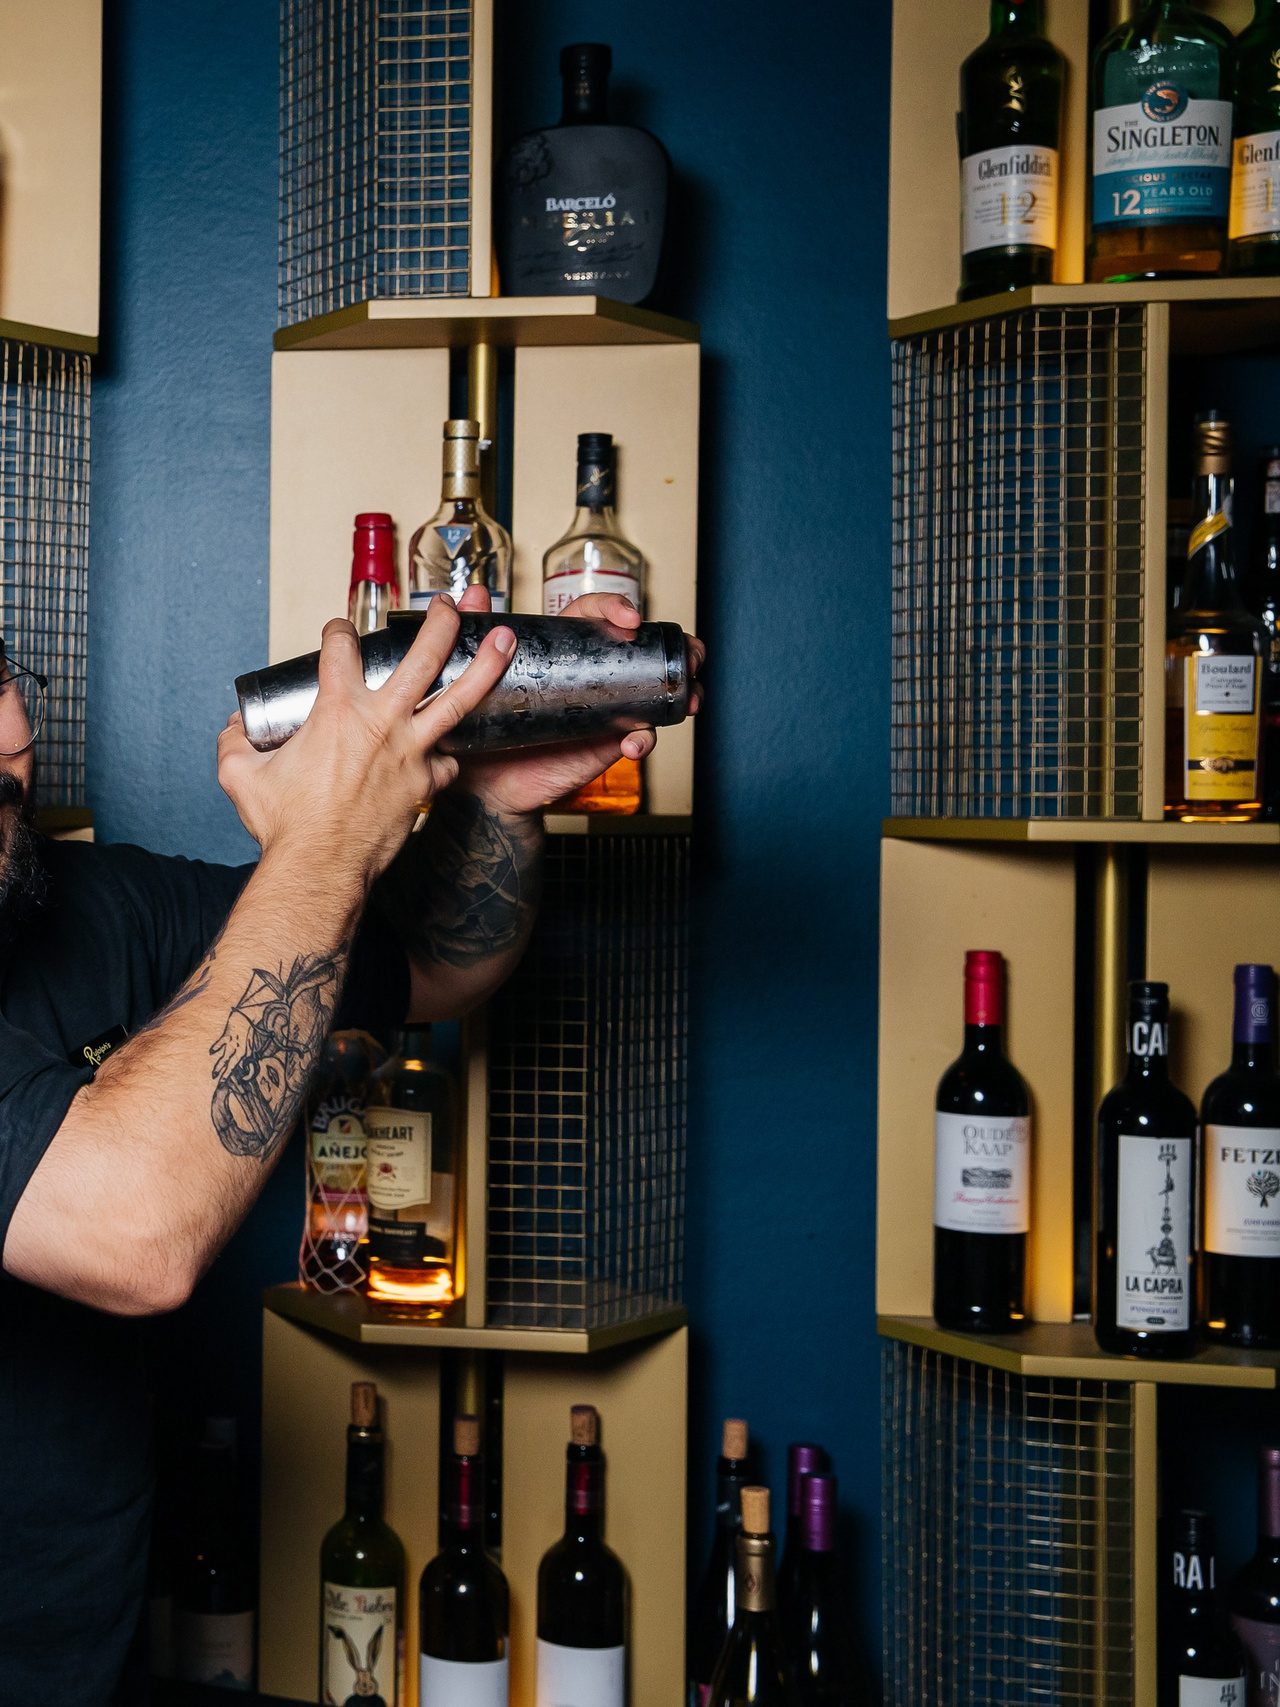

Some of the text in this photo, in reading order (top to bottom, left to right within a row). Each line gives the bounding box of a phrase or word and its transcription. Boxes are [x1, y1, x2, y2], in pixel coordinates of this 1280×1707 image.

[1107, 125, 1220, 153] SINGLETON
[545, 192, 617, 212] BARCELÓ
[1111, 189, 1141, 217] 12
[1142, 187, 1185, 198] YEARS
[1189, 186, 1213, 197] OLD
[447, 528, 461, 540] 12
[1125, 1276, 1184, 1294] LA CAPRA
